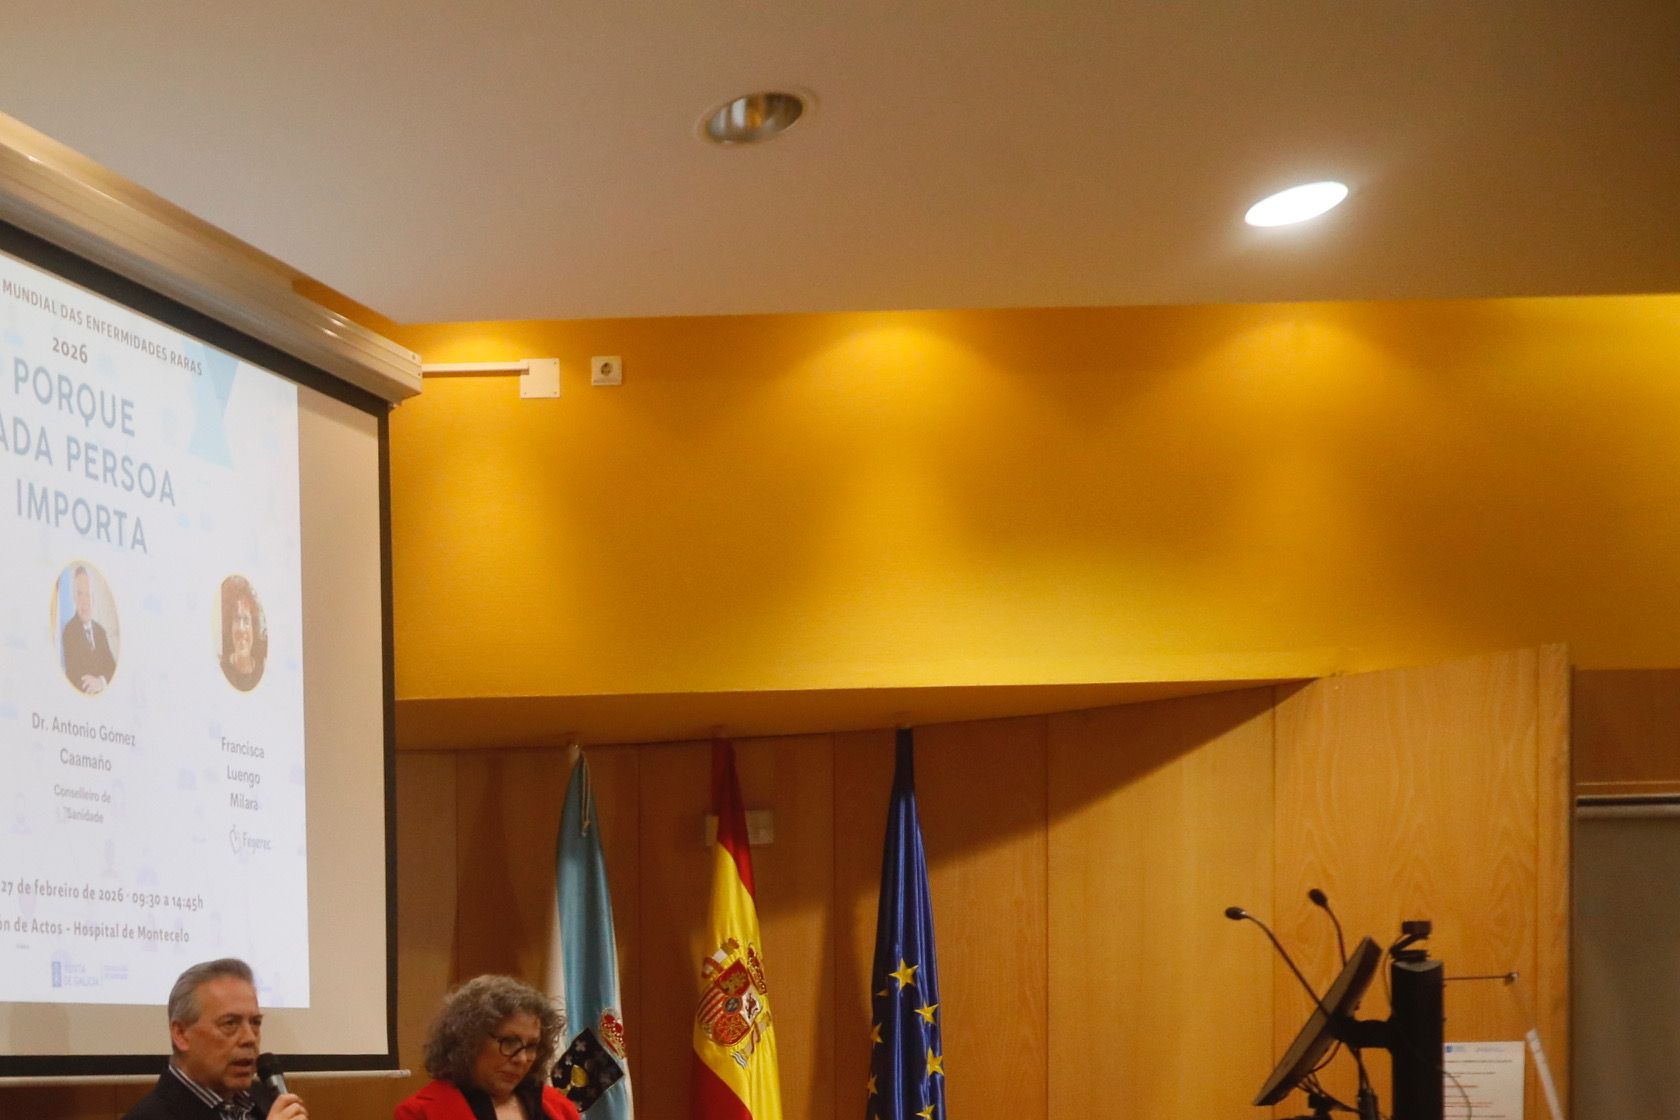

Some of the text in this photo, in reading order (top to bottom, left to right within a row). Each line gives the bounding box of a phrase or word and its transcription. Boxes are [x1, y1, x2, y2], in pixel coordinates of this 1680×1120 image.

[2, 279, 57, 315] MUNDIAL
[60, 303, 82, 325] DAS
[86, 315, 167, 361] ENFERMIDADES
[170, 351, 203, 376] RARAS
[52, 337, 88, 363] 2026
[14, 357, 135, 437] PORQUE
[66, 435, 175, 507] PERSOA
[16, 478, 148, 554] IMPORTA
[31, 712, 136, 746] Dr. Antonio Gómez
[60, 748, 112, 771] Caamaño
[221, 736, 265, 758] Francisca
[226, 765, 261, 788] Luengo
[1, 880, 13, 895] 27
[17, 879, 30, 894] de
[34, 879, 80, 898] febreiro
[83, 885, 96, 900] de
[99, 887, 123, 902] 2026
[132, 892, 161, 909] 09:30
[164, 897, 170, 906] a
[14, 917, 28, 933] de
[31, 918, 63, 935] Actos
[73, 921, 119, 942] Hospital
[122, 925, 134, 940] de
[137, 925, 190, 943] Montecelo
